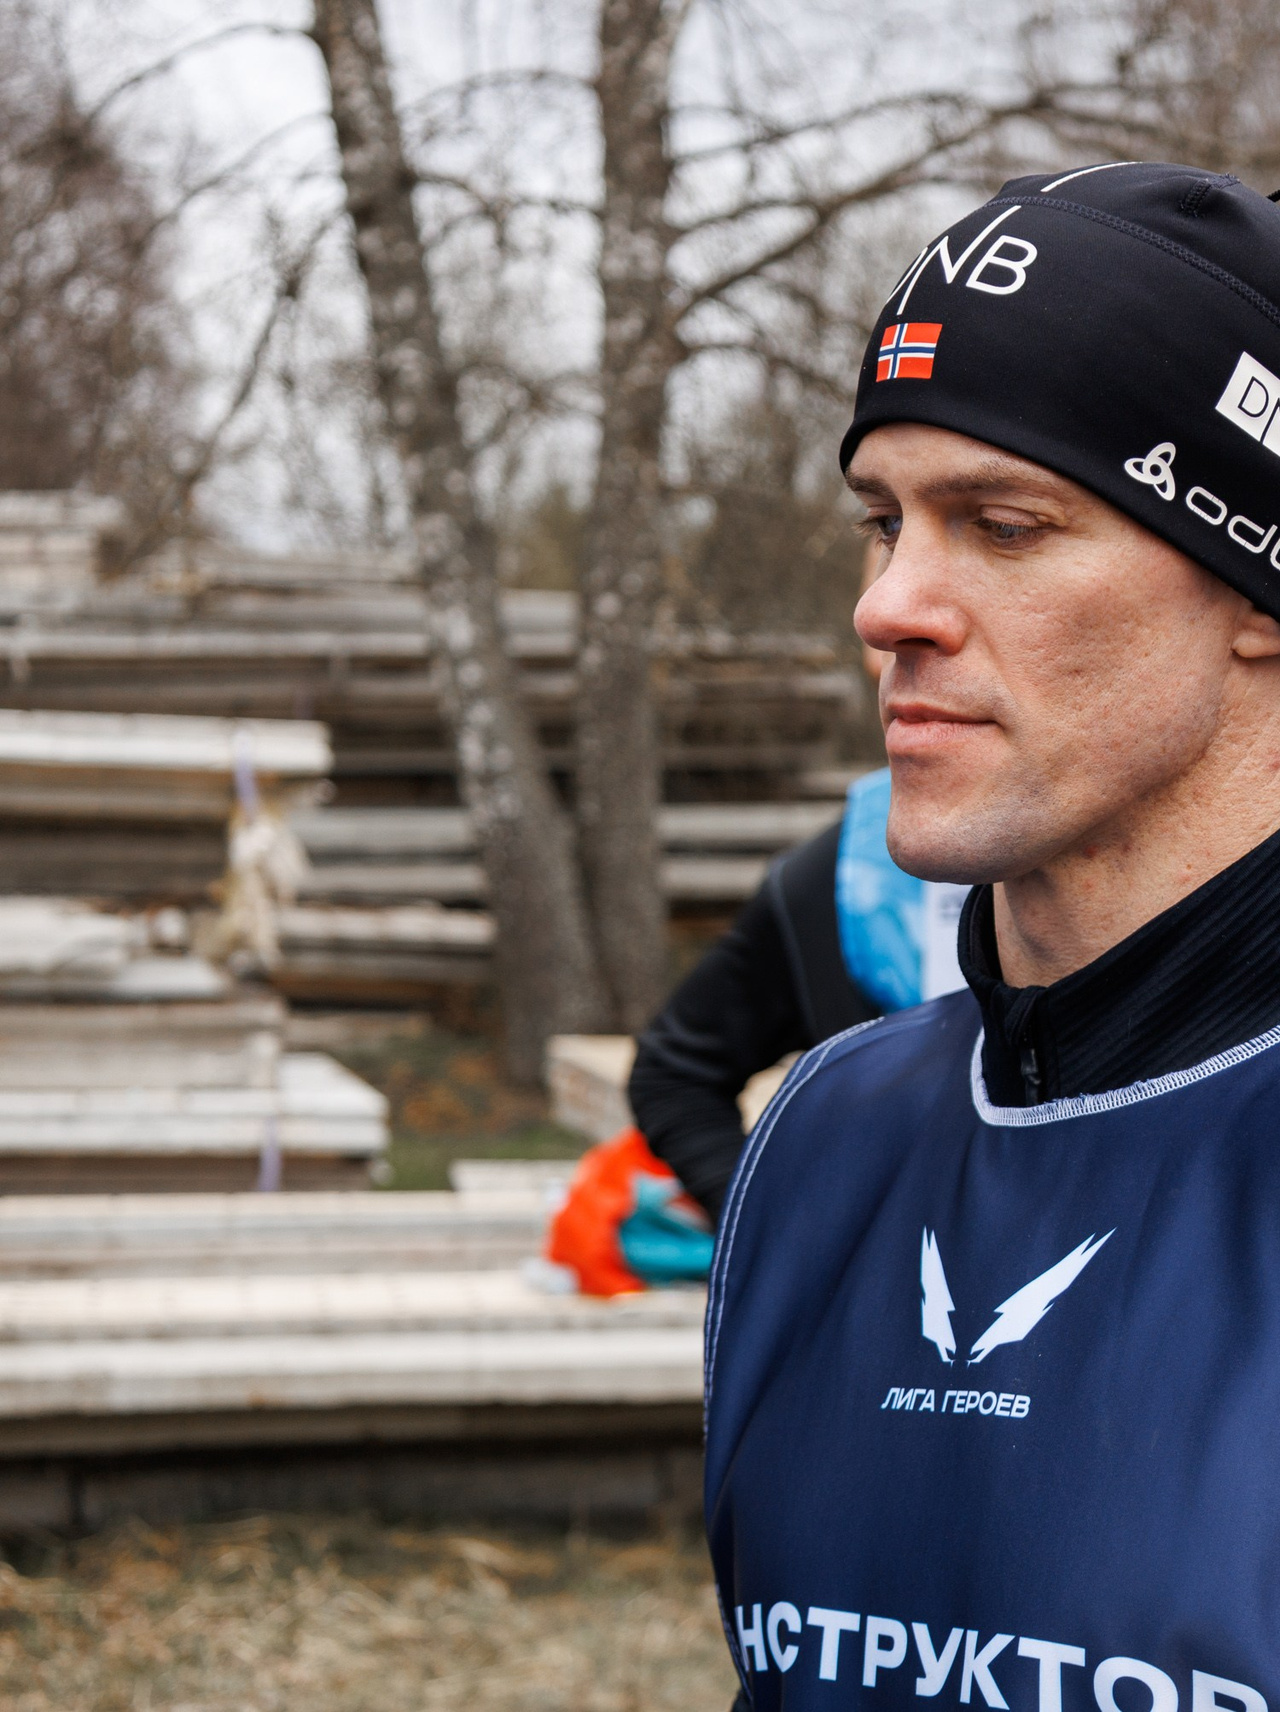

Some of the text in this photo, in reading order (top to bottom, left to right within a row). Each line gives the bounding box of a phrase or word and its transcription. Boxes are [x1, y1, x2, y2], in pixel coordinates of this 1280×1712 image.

[886, 205, 1038, 314] NB
[881, 1387, 1032, 1418] ЛИГА ГЕРОЕВ
